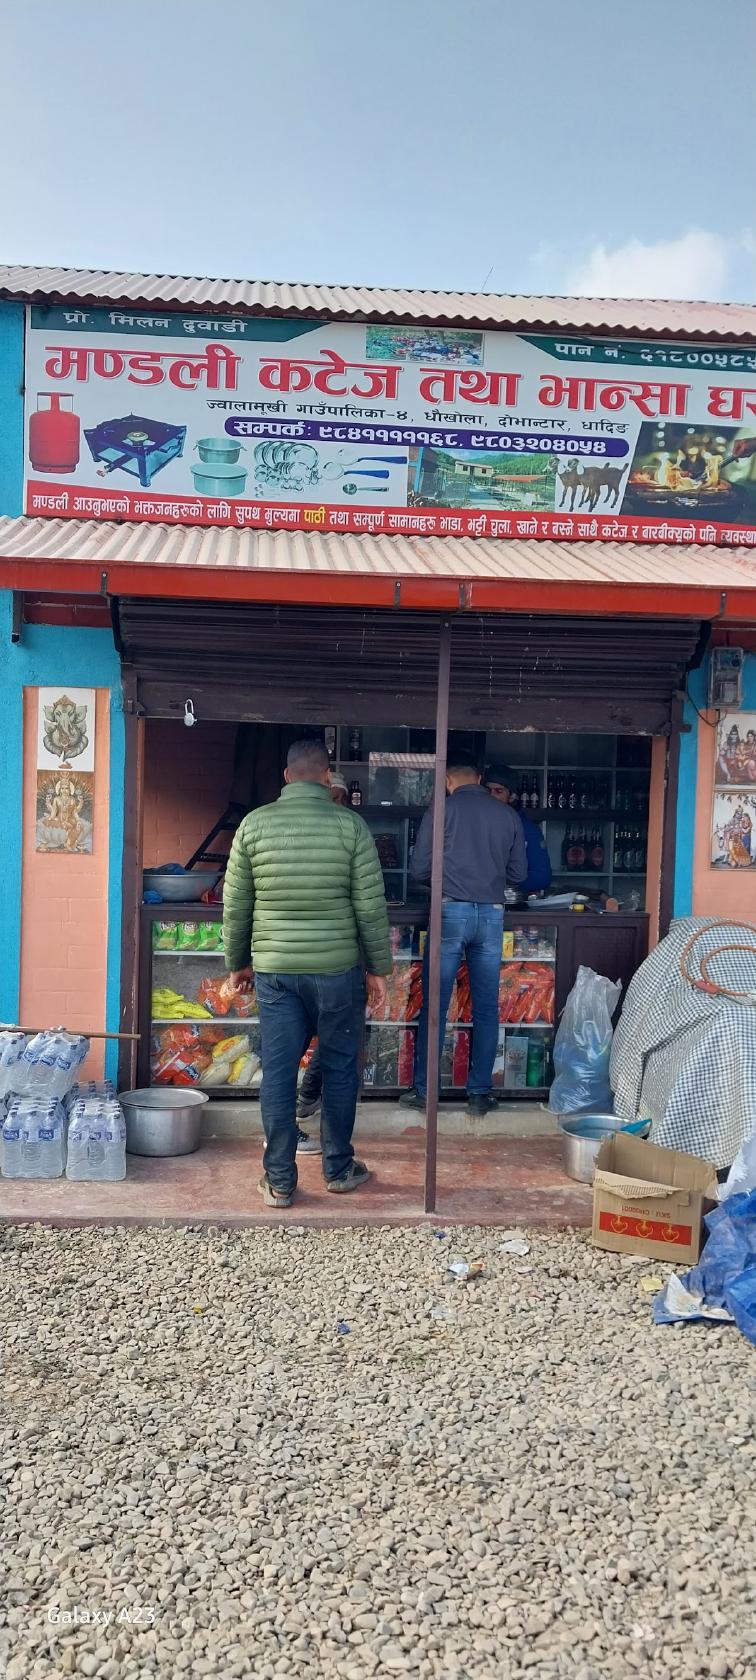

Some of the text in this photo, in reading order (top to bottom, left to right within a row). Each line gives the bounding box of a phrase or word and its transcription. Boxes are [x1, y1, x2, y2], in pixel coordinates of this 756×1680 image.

[108, 312, 172, 328] मिलन
[554, 343, 595, 356] पान
[44, 343, 242, 391] मण्डली
[258, 349, 404, 400] कटेज
[418, 367, 523, 408] तथा
[537, 374, 692, 418] भान्सा
[471, 433, 607, 454] ९८०३२०४०५४
[32, 492, 69, 510] मण्डली
[73, 496, 130, 516] आउनुभएको
[207, 501, 231, 518] लागि
[235, 506, 260, 524] सुपथ
[304, 506, 326, 524] पाठी
[329, 511, 350, 525] तथा
[353, 511, 385, 531] सम्पूर्ण
[516, 517, 538, 534] खाने
[542, 521, 549, 534] र
[552, 518, 574, 536] बस्ने
[578, 518, 599, 537] साथै
[602, 520, 629, 537] कटेज
[632, 525, 639, 538] र
[699, 524, 717, 542] पनि
